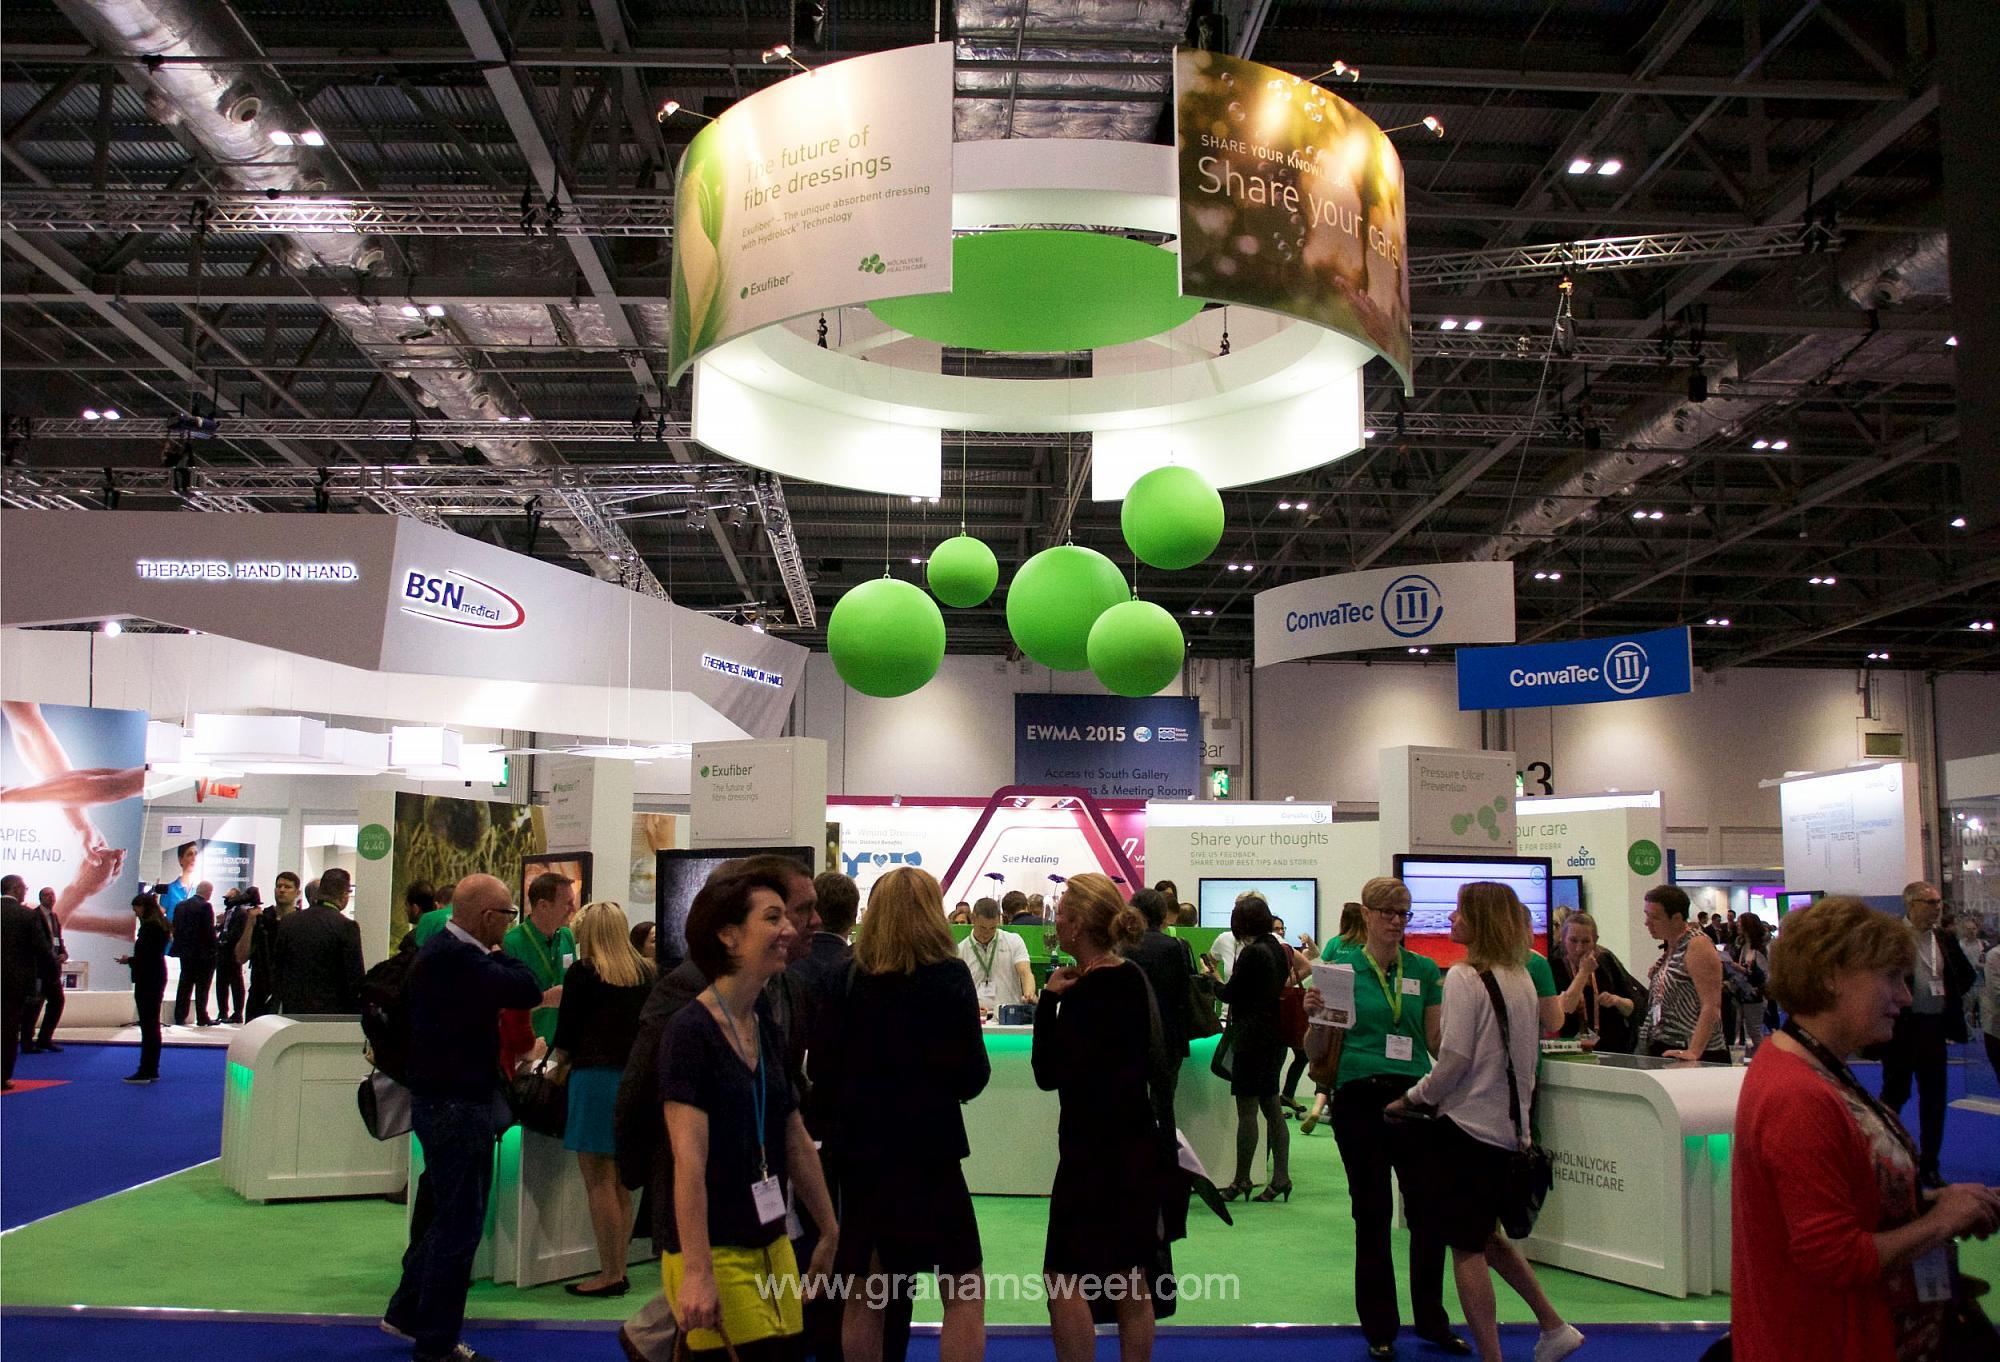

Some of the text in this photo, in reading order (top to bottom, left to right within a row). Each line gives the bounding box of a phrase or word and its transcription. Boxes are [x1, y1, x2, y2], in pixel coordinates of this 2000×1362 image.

[780, 136, 841, 171] future
[848, 125, 872, 152] of
[1201, 134, 1247, 154] SHARE
[1251, 144, 1283, 164] YOUR
[743, 154, 893, 212] fibre dressings
[784, 210, 800, 223] The
[801, 203, 831, 218] unique
[833, 190, 882, 209] absorbent
[885, 185, 931, 200] dressing
[1198, 156, 1400, 270] Share your care
[802, 212, 853, 230] Technology
[137, 563, 358, 579] THERAPIES. HAND IN HAND.
[405, 572, 465, 610] BSN
[460, 603, 501, 620] medical
[1286, 602, 1375, 633] ConvaTec
[1509, 664, 1600, 687] ConvaTec
[1026, 725, 1126, 742] EWMA 2015
[1044, 768, 1169, 782] Access to South Gallery
[1420, 766, 1460, 779] Pressure
[1527, 761, 1554, 795] 3
[1101, 787, 1109, 796] &
[1112, 786, 1154, 798] Meeting
[1158, 787, 1193, 796] Rooms
[1420, 780, 1468, 792] Prevention
[1540, 823, 1568, 836] care
[1190, 831, 1329, 849] Share your thoughts
[3, 847, 66, 862] IN HAND.
[1002, 855, 1060, 865] See Healing
[1567, 856, 1596, 867] debra
[1554, 1167, 1625, 1192] HEALTH CARE
